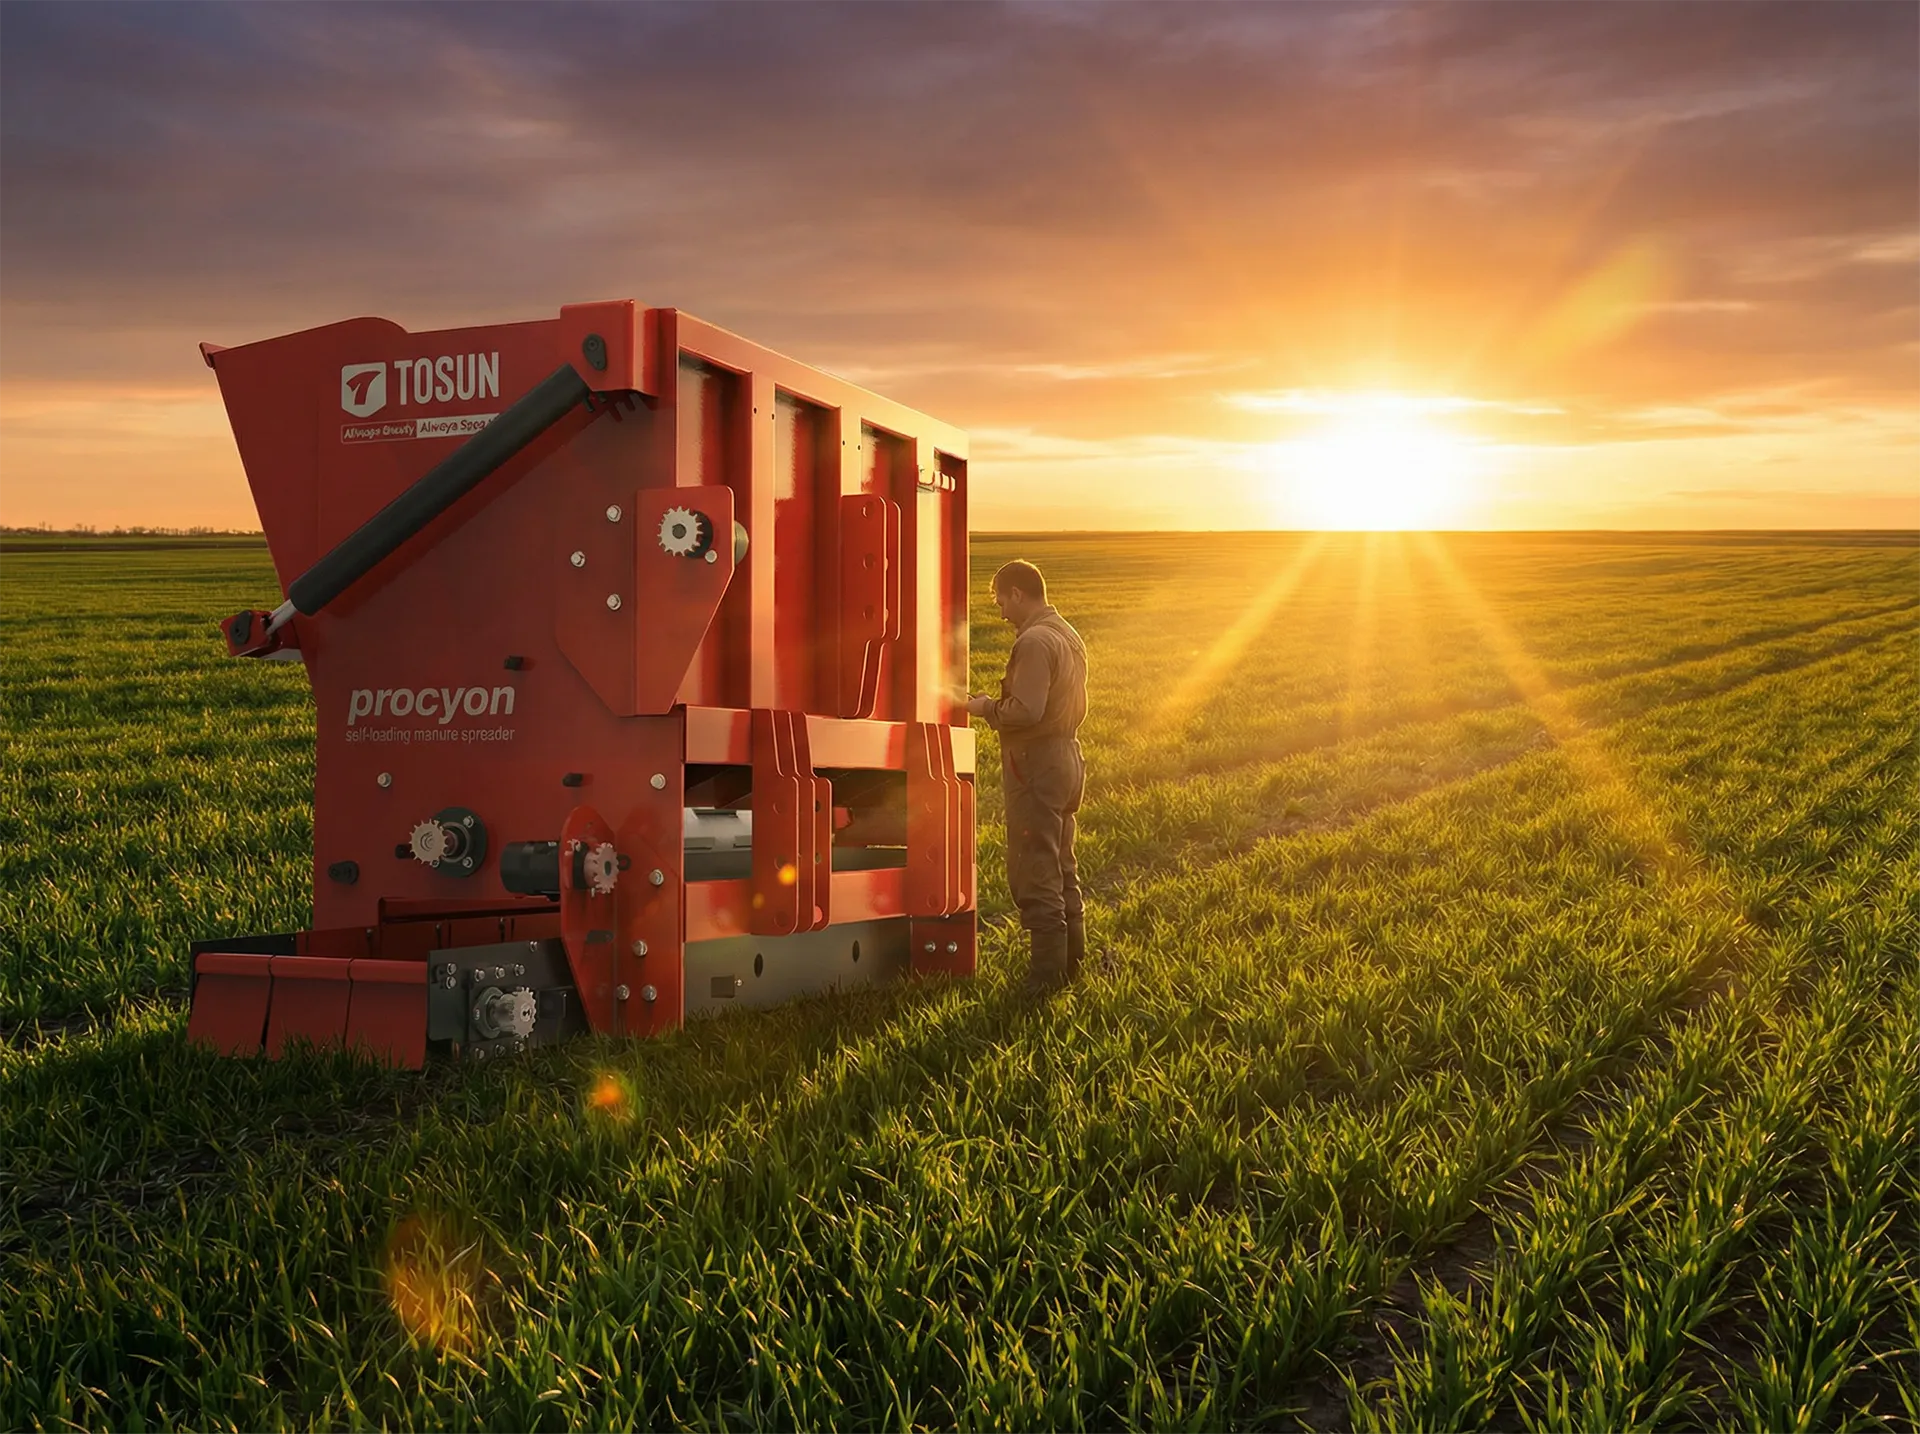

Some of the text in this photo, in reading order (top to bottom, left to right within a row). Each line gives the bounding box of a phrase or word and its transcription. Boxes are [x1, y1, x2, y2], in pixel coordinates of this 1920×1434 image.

[394, 352, 499, 405] TOSUN
[347, 686, 515, 725] procyon
[345, 726, 515, 744] self-loading manure spreader
